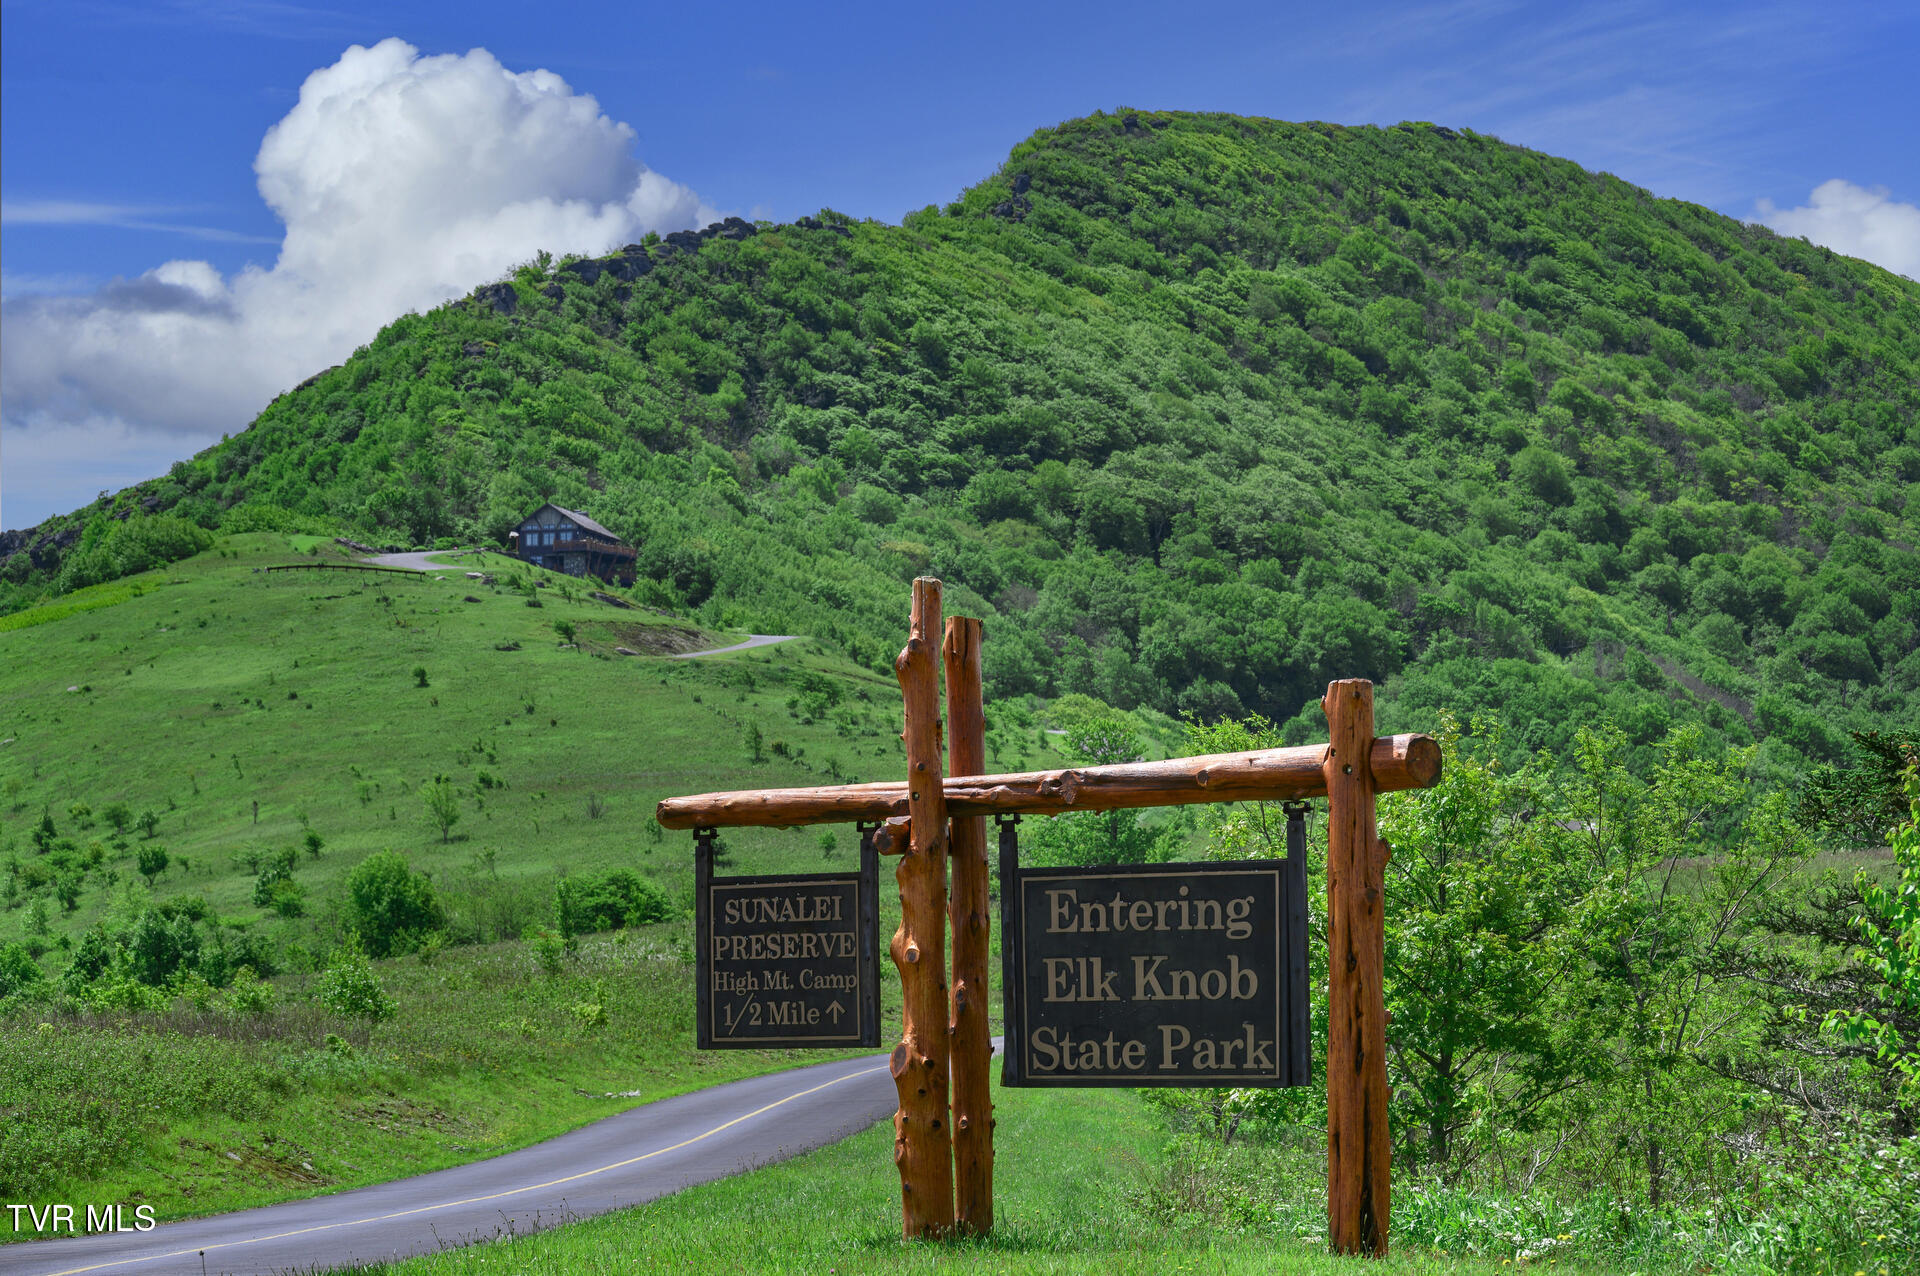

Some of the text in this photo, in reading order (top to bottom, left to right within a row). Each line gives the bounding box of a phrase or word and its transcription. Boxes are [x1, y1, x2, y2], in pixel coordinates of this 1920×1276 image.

[725, 896, 842, 924] SUNALEI
[1045, 885, 1254, 939] Entering
[714, 932, 856, 960] PRESERVE
[714, 968, 857, 996] High Mt. Camp
[1043, 954, 1258, 1002] Elk Knob
[723, 992, 820, 1035] 1/2 Mile
[1031, 1023, 1274, 1070] State Park
